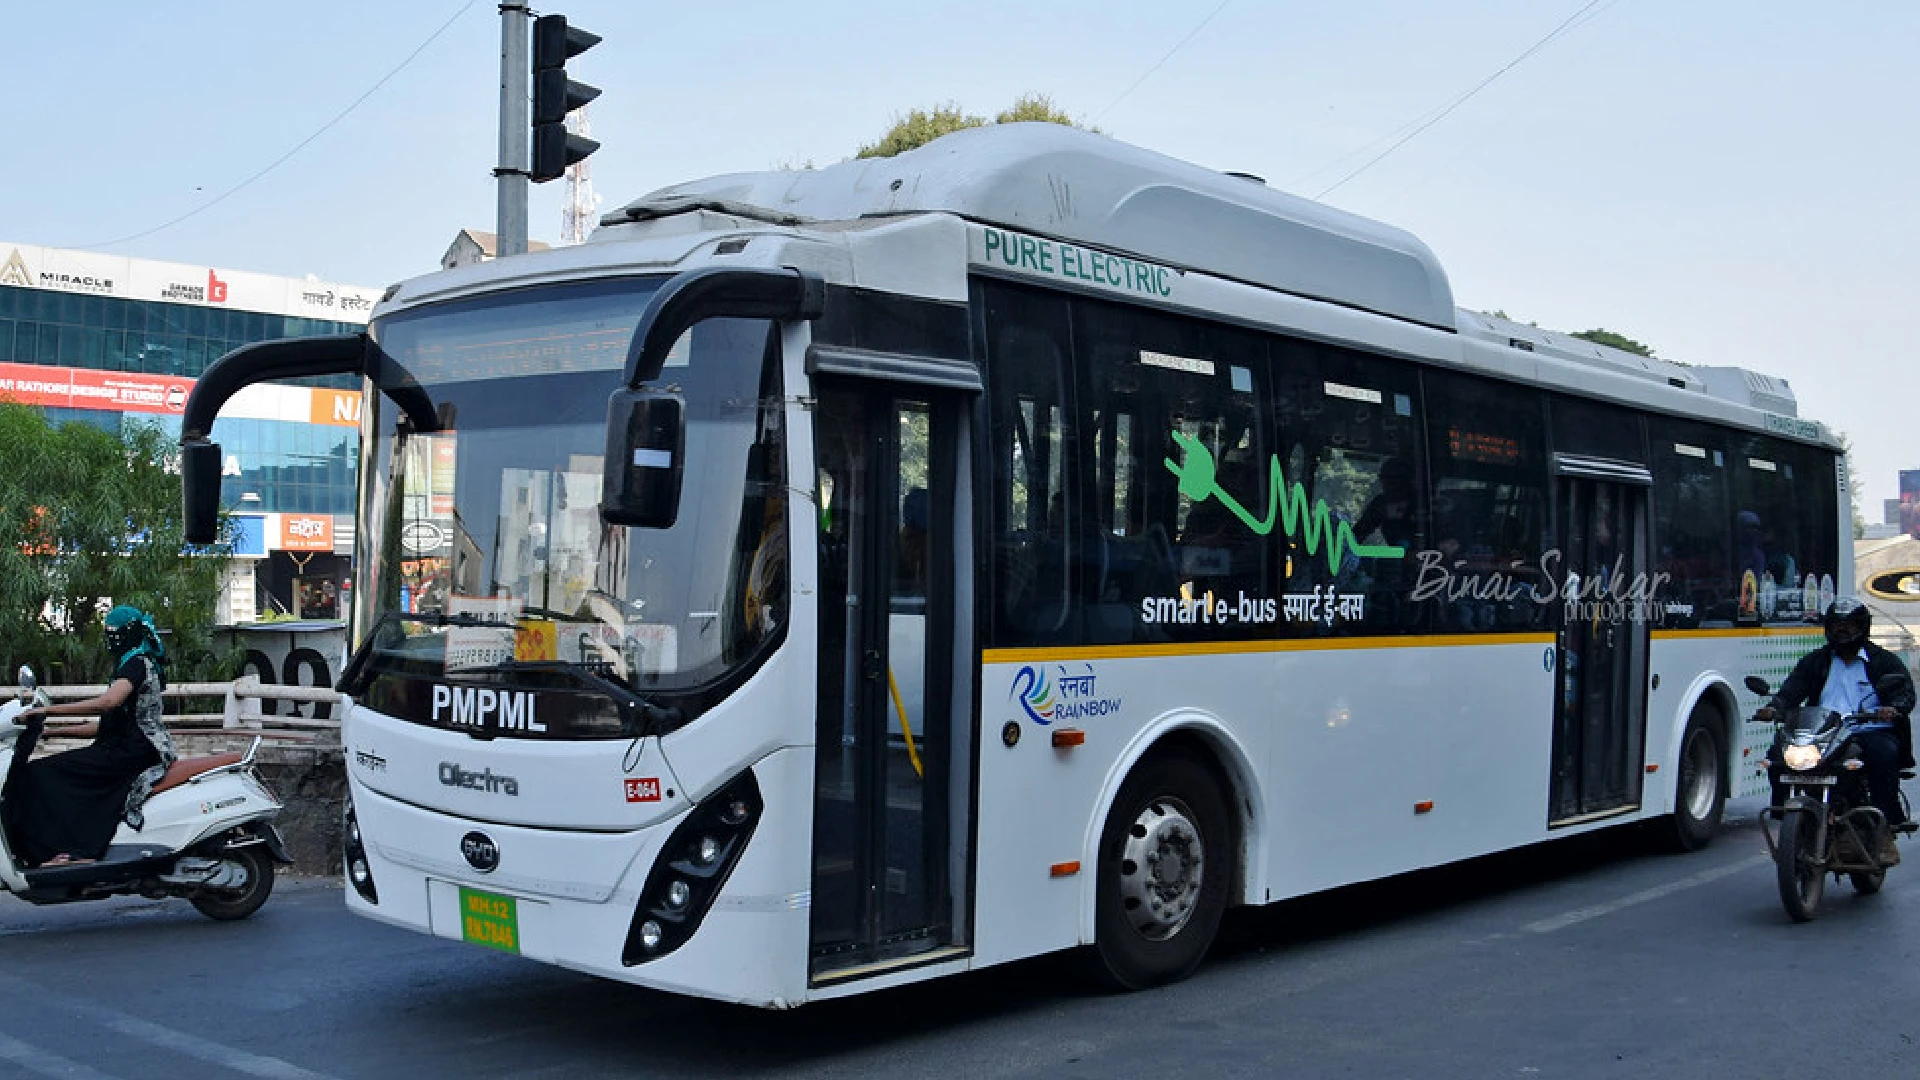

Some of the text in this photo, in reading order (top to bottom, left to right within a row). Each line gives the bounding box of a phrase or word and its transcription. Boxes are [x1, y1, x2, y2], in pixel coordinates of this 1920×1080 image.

[40, 272, 113, 288] MIRACLE
[985, 229, 1172, 297] PURE ELECTRIC
[70, 384, 117, 398] DESIGN
[120, 388, 163, 400] STUDIO
[1142, 585, 1364, 627] smart e-bus स्मार्ट ई-बस
[1058, 663, 1097, 698] रेनबो
[432, 685, 546, 732] PMPML
[1055, 698, 1121, 720] RAINBOW
[438, 761, 518, 796] Olectra
